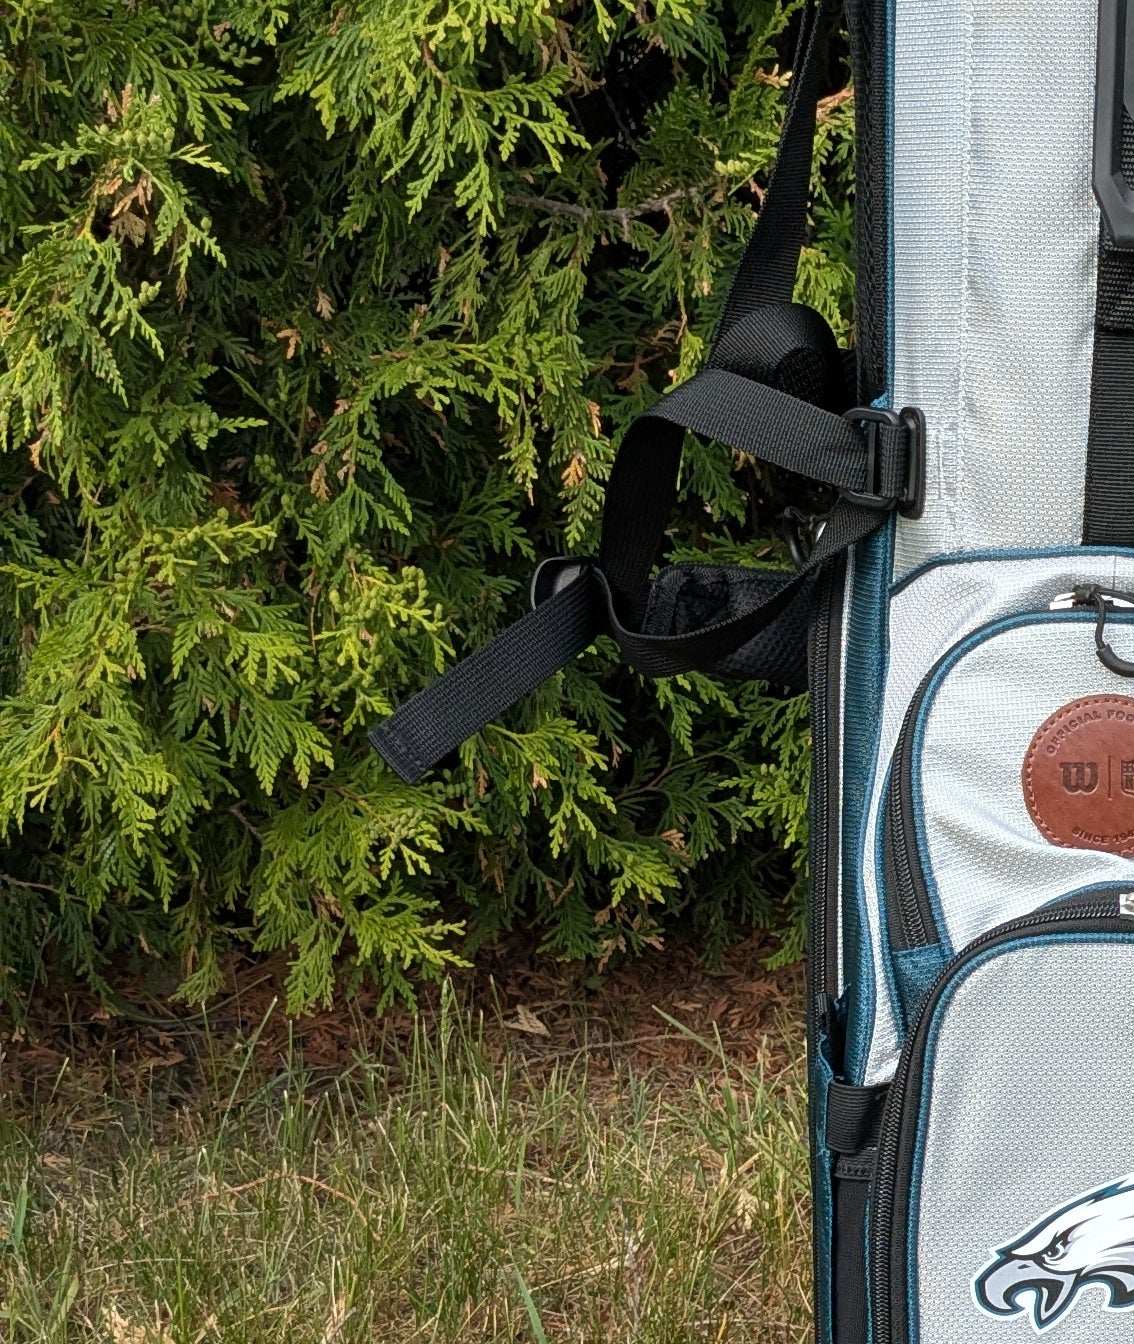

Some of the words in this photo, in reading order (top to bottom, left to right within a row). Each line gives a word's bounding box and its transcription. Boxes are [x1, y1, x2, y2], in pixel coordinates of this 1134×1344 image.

[1046, 710, 1102, 756] OFFICIAL
[1059, 762, 1099, 795] W
[1072, 826, 1110, 845] SINCE
